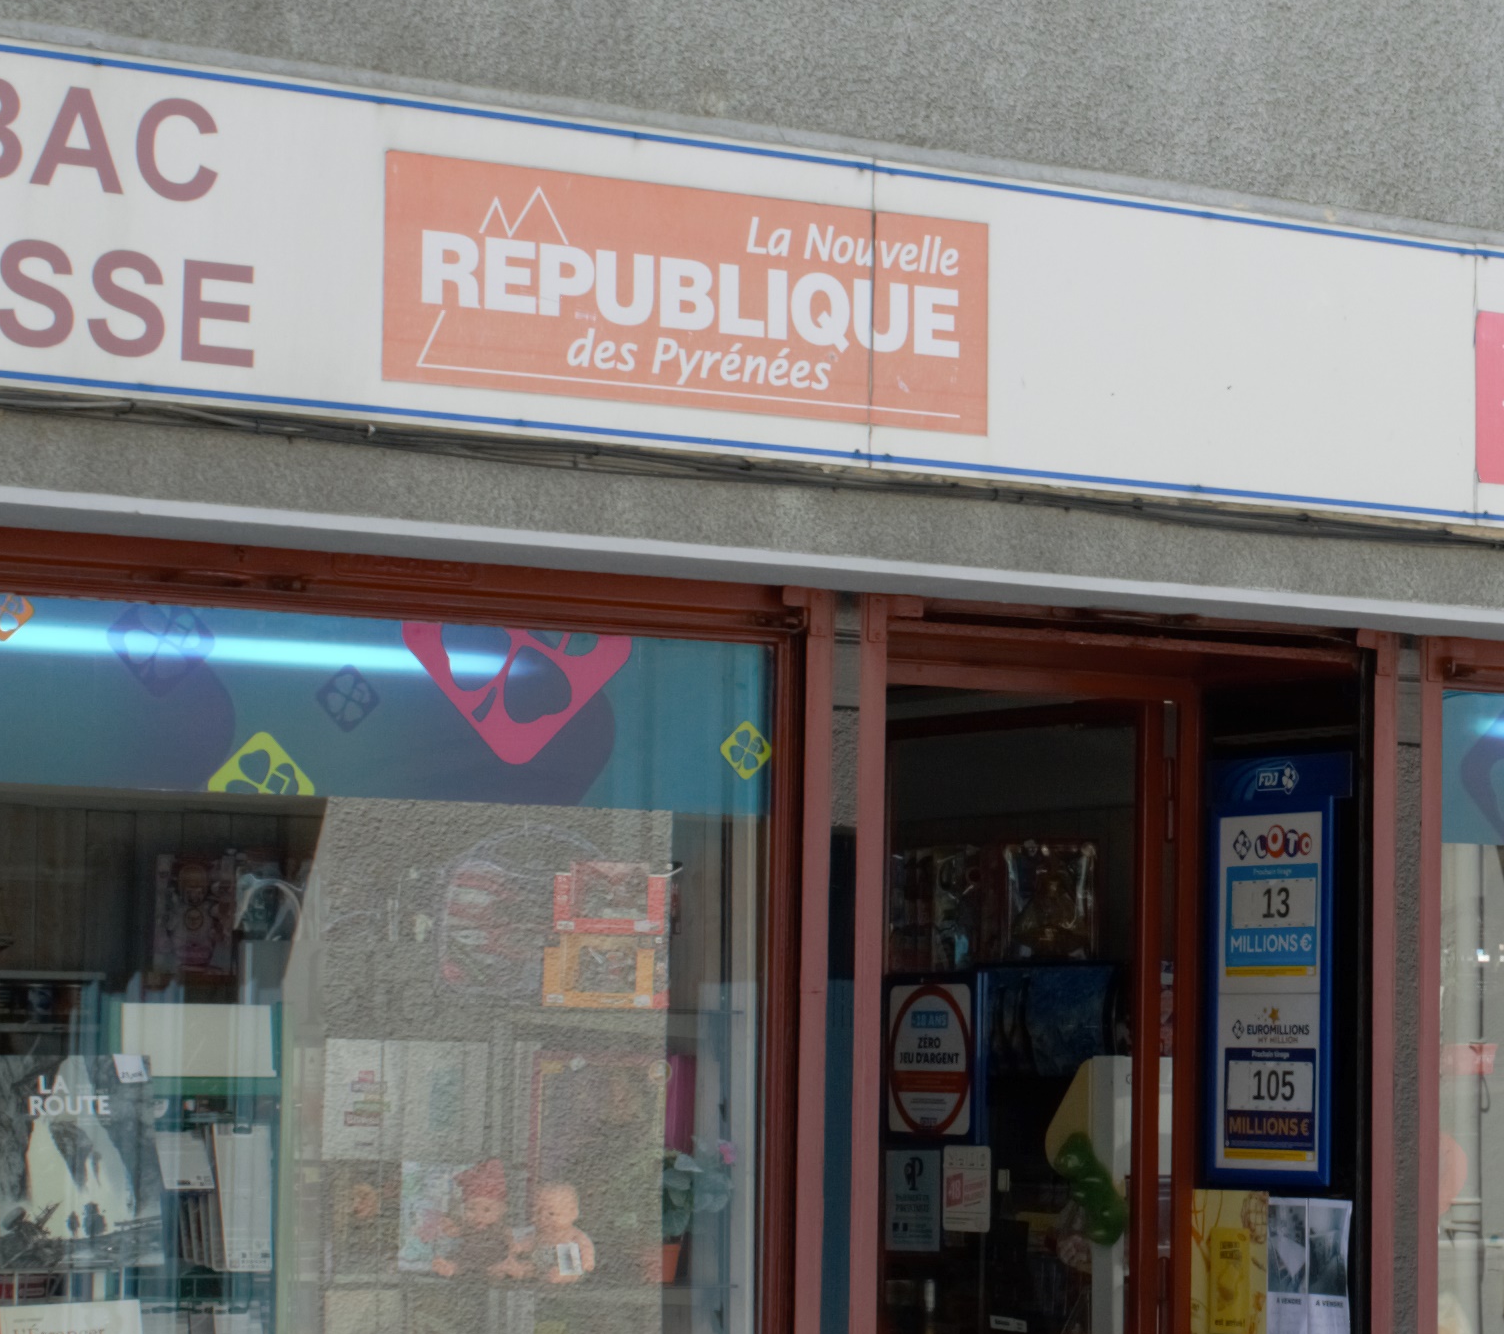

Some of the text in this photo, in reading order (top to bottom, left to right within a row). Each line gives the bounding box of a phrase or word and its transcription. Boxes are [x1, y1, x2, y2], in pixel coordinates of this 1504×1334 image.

[745, 216, 960, 277] La Nouvelle
[566, 327, 833, 392] des Pyrénées
[1258, 774, 1279, 787] FDJ
[1255, 824, 1312, 859] LOTO
[1262, 886, 1291, 919] 13
[918, 1033, 941, 1048] ZÉRO
[1247, 1024, 1310, 1036] EUROMILLIONS
[899, 1052, 960, 1065] JEU D'ARGENT
[37, 1074, 69, 1095] LA
[1252, 1069, 1296, 1102] 105
[27, 1095, 111, 1117] ROUTE
[1322, 1299, 1344, 1308] VENDRE
